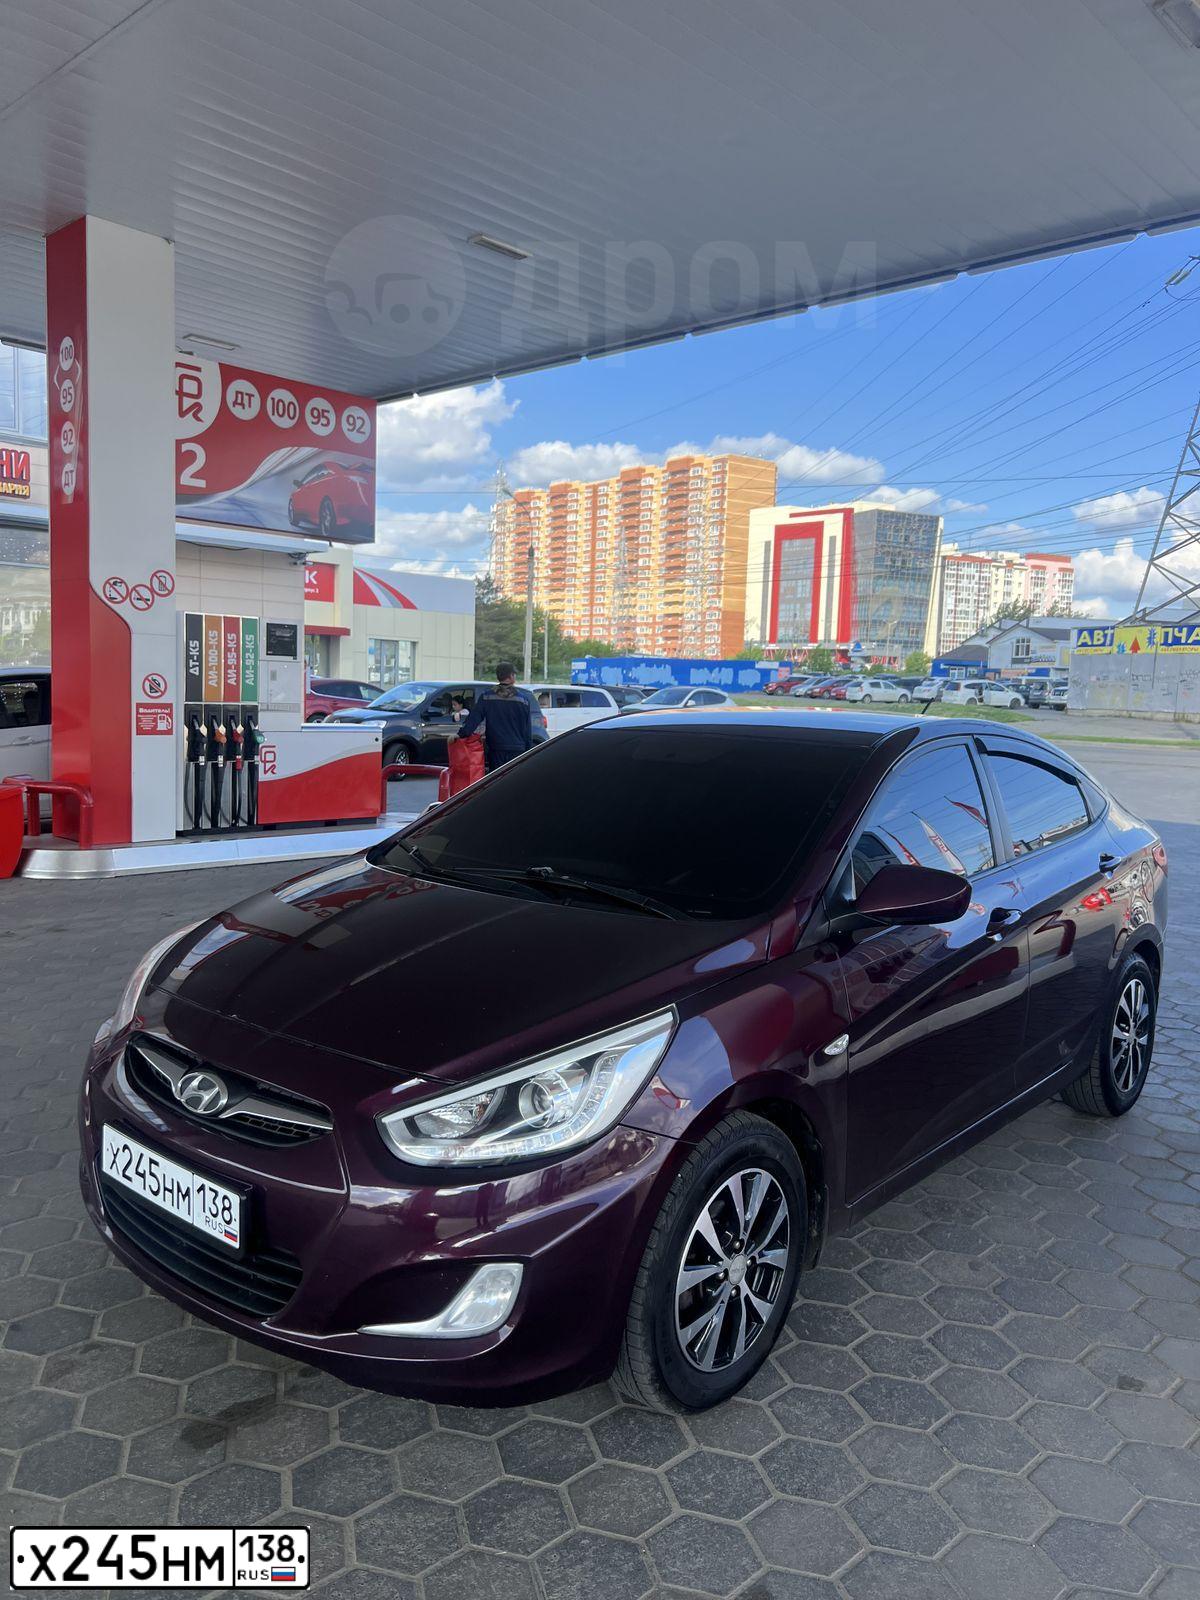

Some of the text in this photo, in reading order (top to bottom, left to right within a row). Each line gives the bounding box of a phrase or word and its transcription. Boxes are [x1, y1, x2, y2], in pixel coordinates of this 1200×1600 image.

[62, 386, 73, 405] 95
[232, 390, 366, 434] ДТ 100 95 92
[62, 429, 74, 447] 92
[179, 442, 207, 488] 2
[64, 469, 74, 489] ДТ
[109, 1142, 232, 1226] Х245НМ 138
[204, 1216, 223, 1234] RUS
